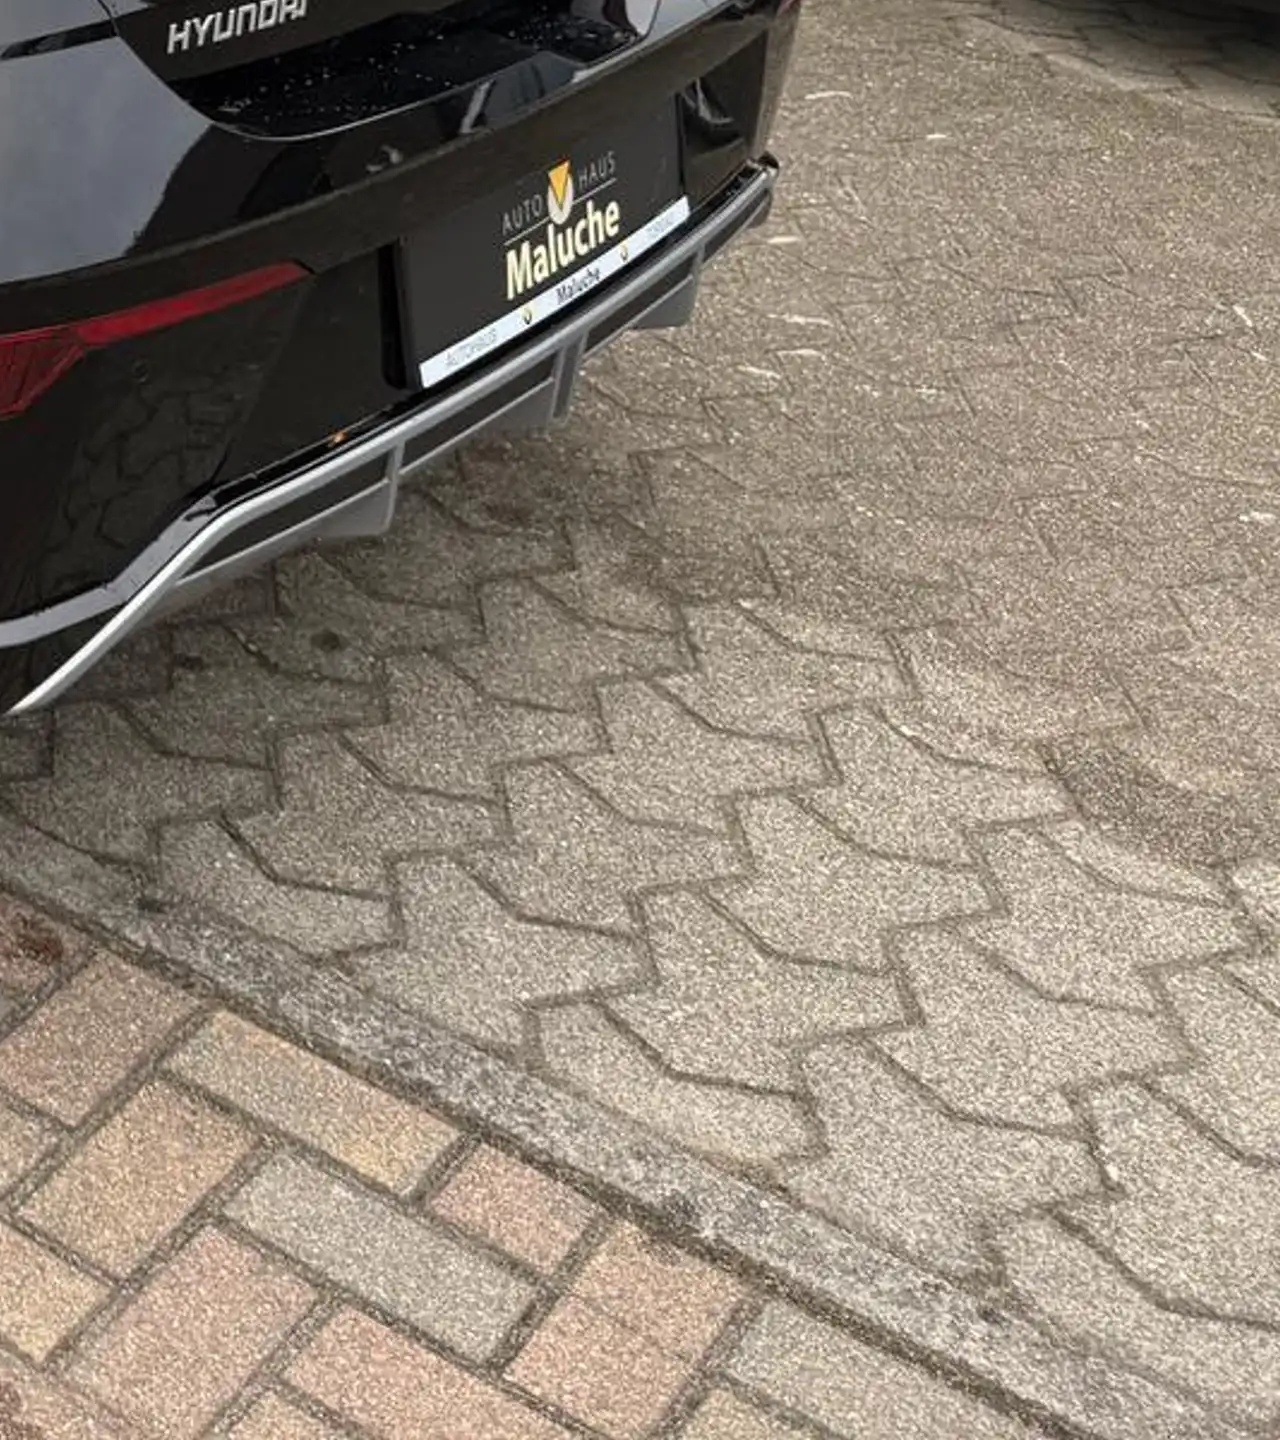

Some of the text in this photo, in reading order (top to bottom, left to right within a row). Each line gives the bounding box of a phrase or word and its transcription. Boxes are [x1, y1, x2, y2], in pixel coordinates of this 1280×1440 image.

[502, 151, 617, 236] AUTO HAUS
[506, 200, 621, 301] Maluche
